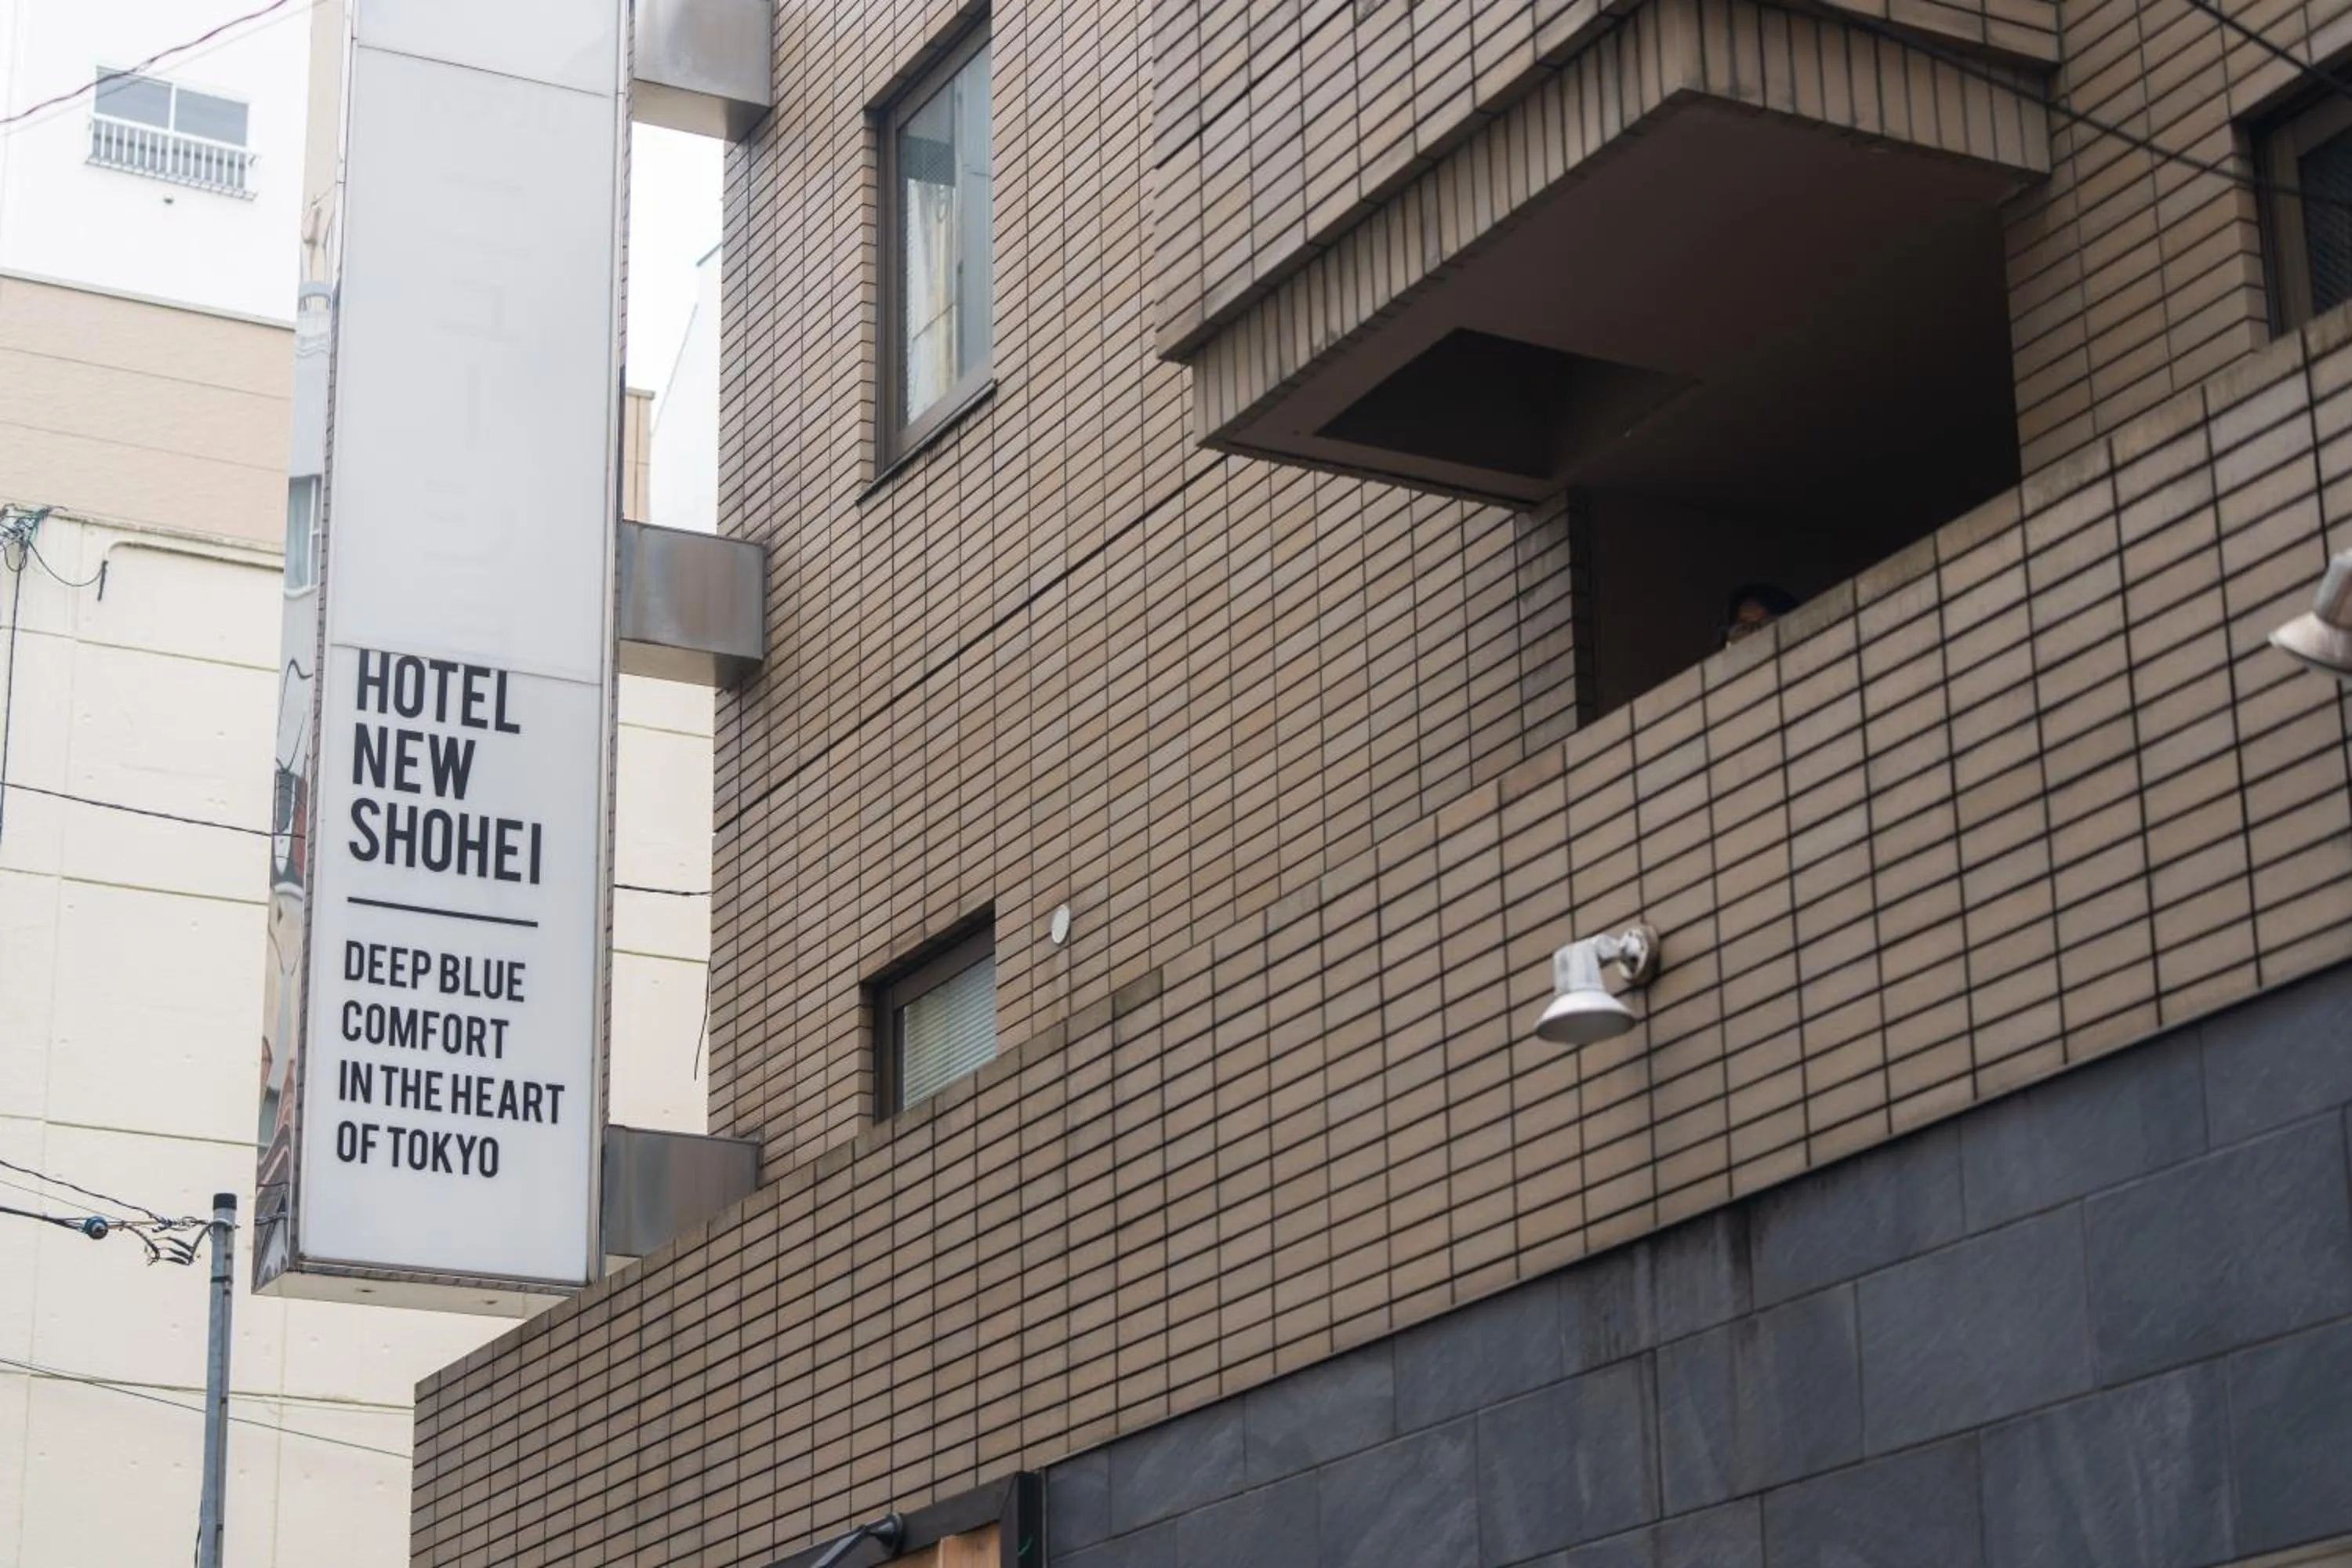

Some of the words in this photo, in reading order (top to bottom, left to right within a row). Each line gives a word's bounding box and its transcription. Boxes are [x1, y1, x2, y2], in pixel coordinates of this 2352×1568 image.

[358, 648, 521, 734] HOTEL
[353, 722, 476, 800] NEW
[349, 797, 542, 885] SHOHEI
[344, 940, 432, 990] DEEP
[439, 953, 526, 1003] BLUE
[342, 1000, 510, 1059] COMFORT
[339, 1059, 372, 1104] IN
[379, 1064, 443, 1112] THE
[451, 1073, 565, 1124] HEART
[336, 1120, 379, 1164] OF
[387, 1125, 499, 1178] TOKYO
